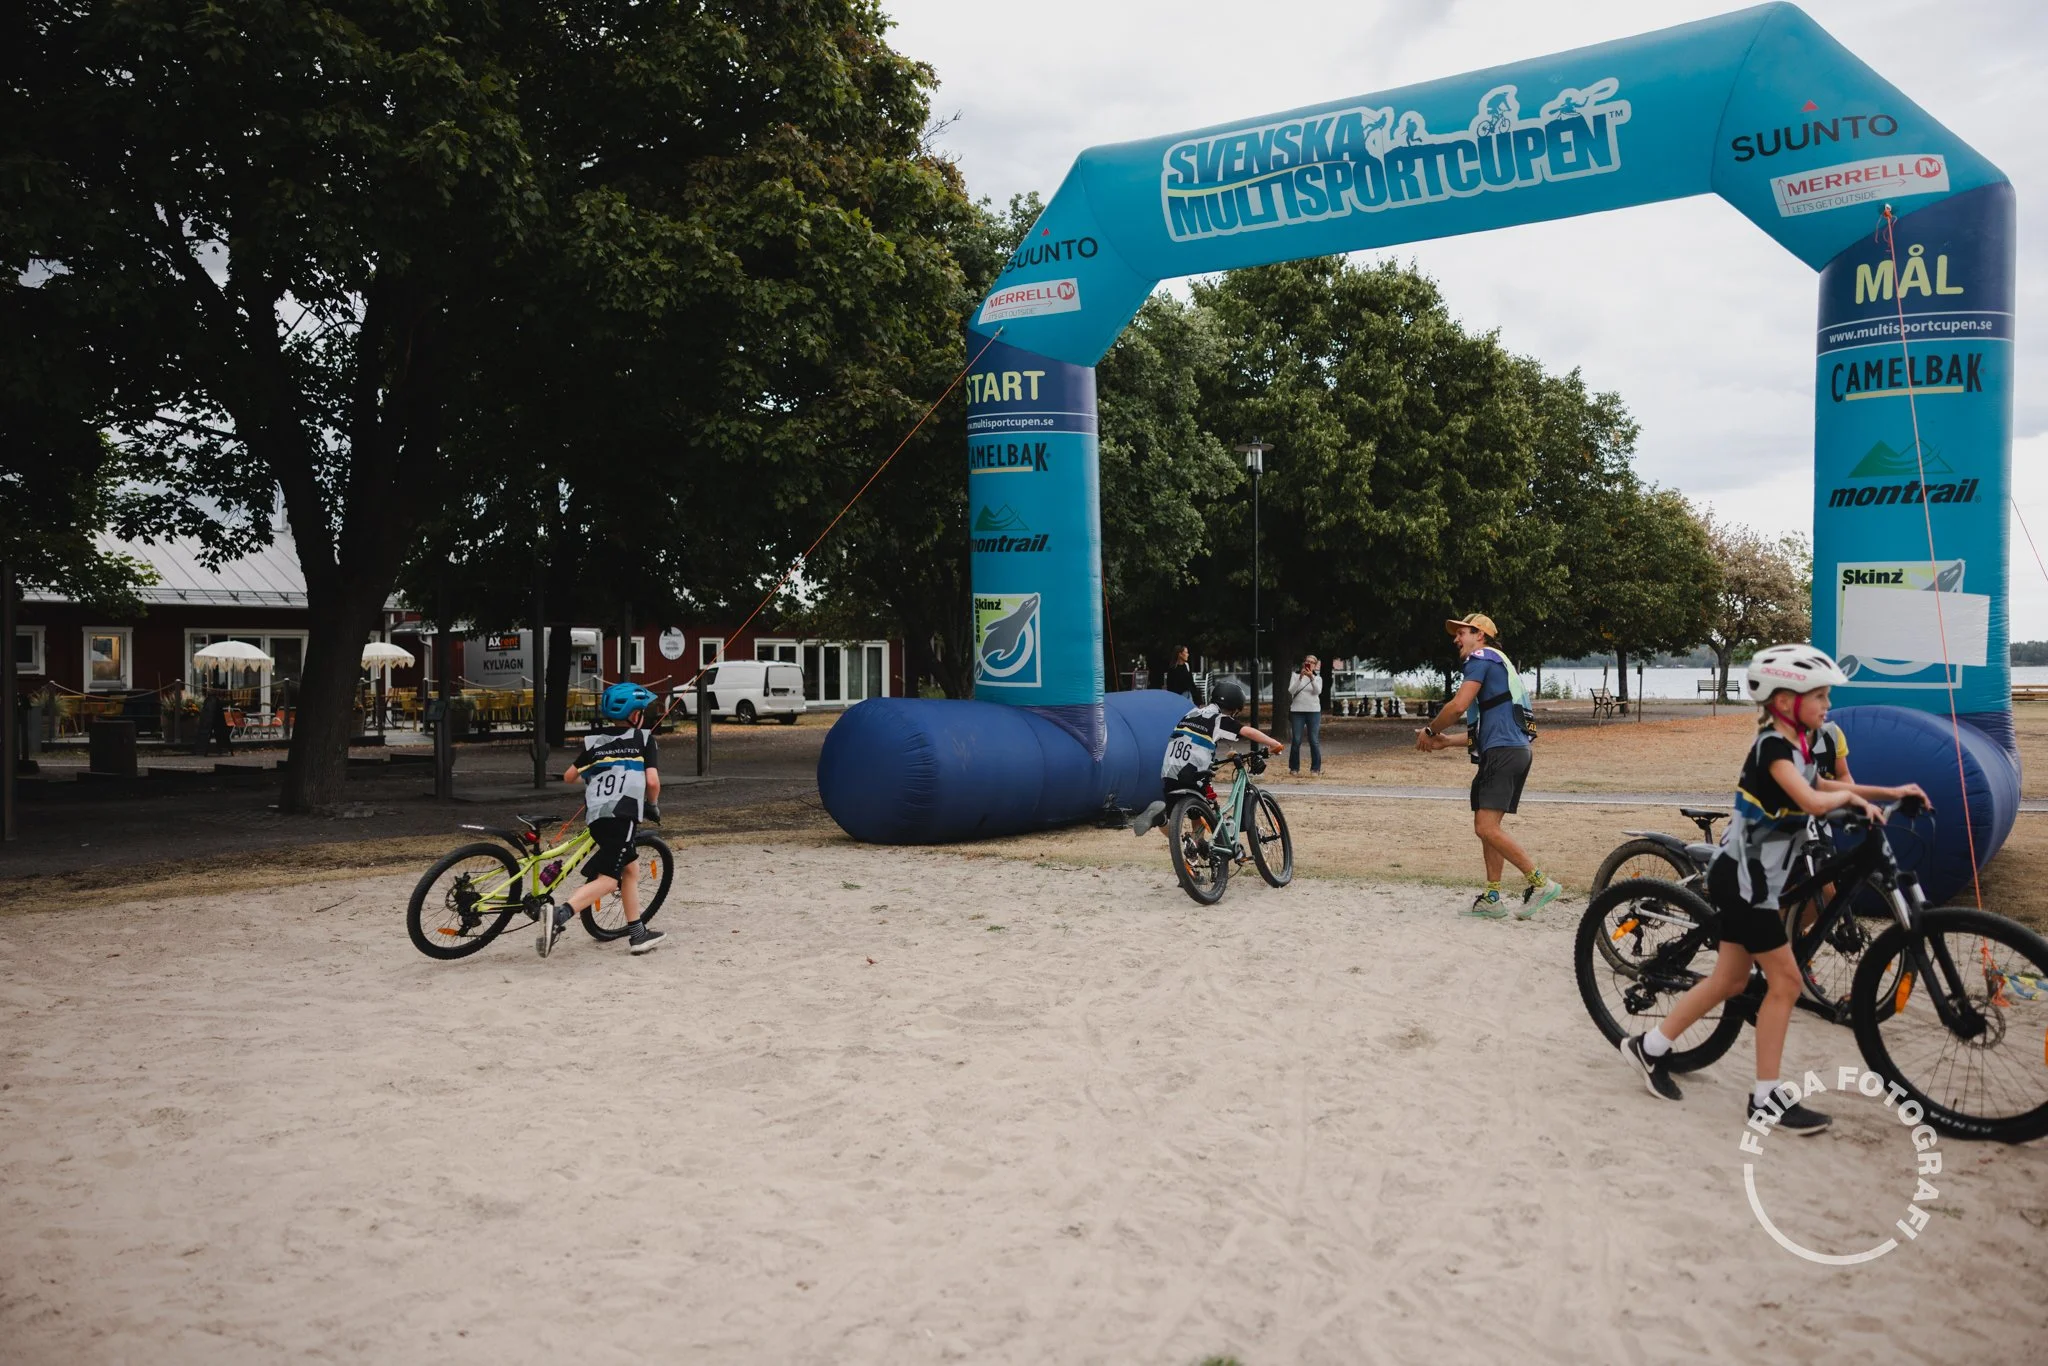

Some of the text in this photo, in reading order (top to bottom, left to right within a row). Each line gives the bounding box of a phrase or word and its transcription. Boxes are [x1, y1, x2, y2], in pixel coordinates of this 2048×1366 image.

[1168, 111, 1367, 185] SVENSKA
[1731, 114, 1898, 162] SUUNTO
[1168, 112, 1615, 237] MULTISPORTCUPEN
[1787, 162, 1914, 197] MERRELL
[1792, 190, 1876, 214] LET'S GET OUTSIDE
[1005, 236, 1098, 274] SUUNTO
[1855, 243, 1964, 304] MÅL
[989, 287, 1057, 308] MERRELL
[1829, 320, 1993, 344] www.multisportcupen.se
[1831, 352, 1983, 403] CAMELBAK
[1828, 478, 1981, 508] montrail
[1842, 569, 1903, 585] Skinz
[975, 598, 1002, 611] Skinz
[483, 658, 524, 671] KYLVAGN
[1169, 740, 1193, 762] 186
[596, 773, 627, 797] 191
